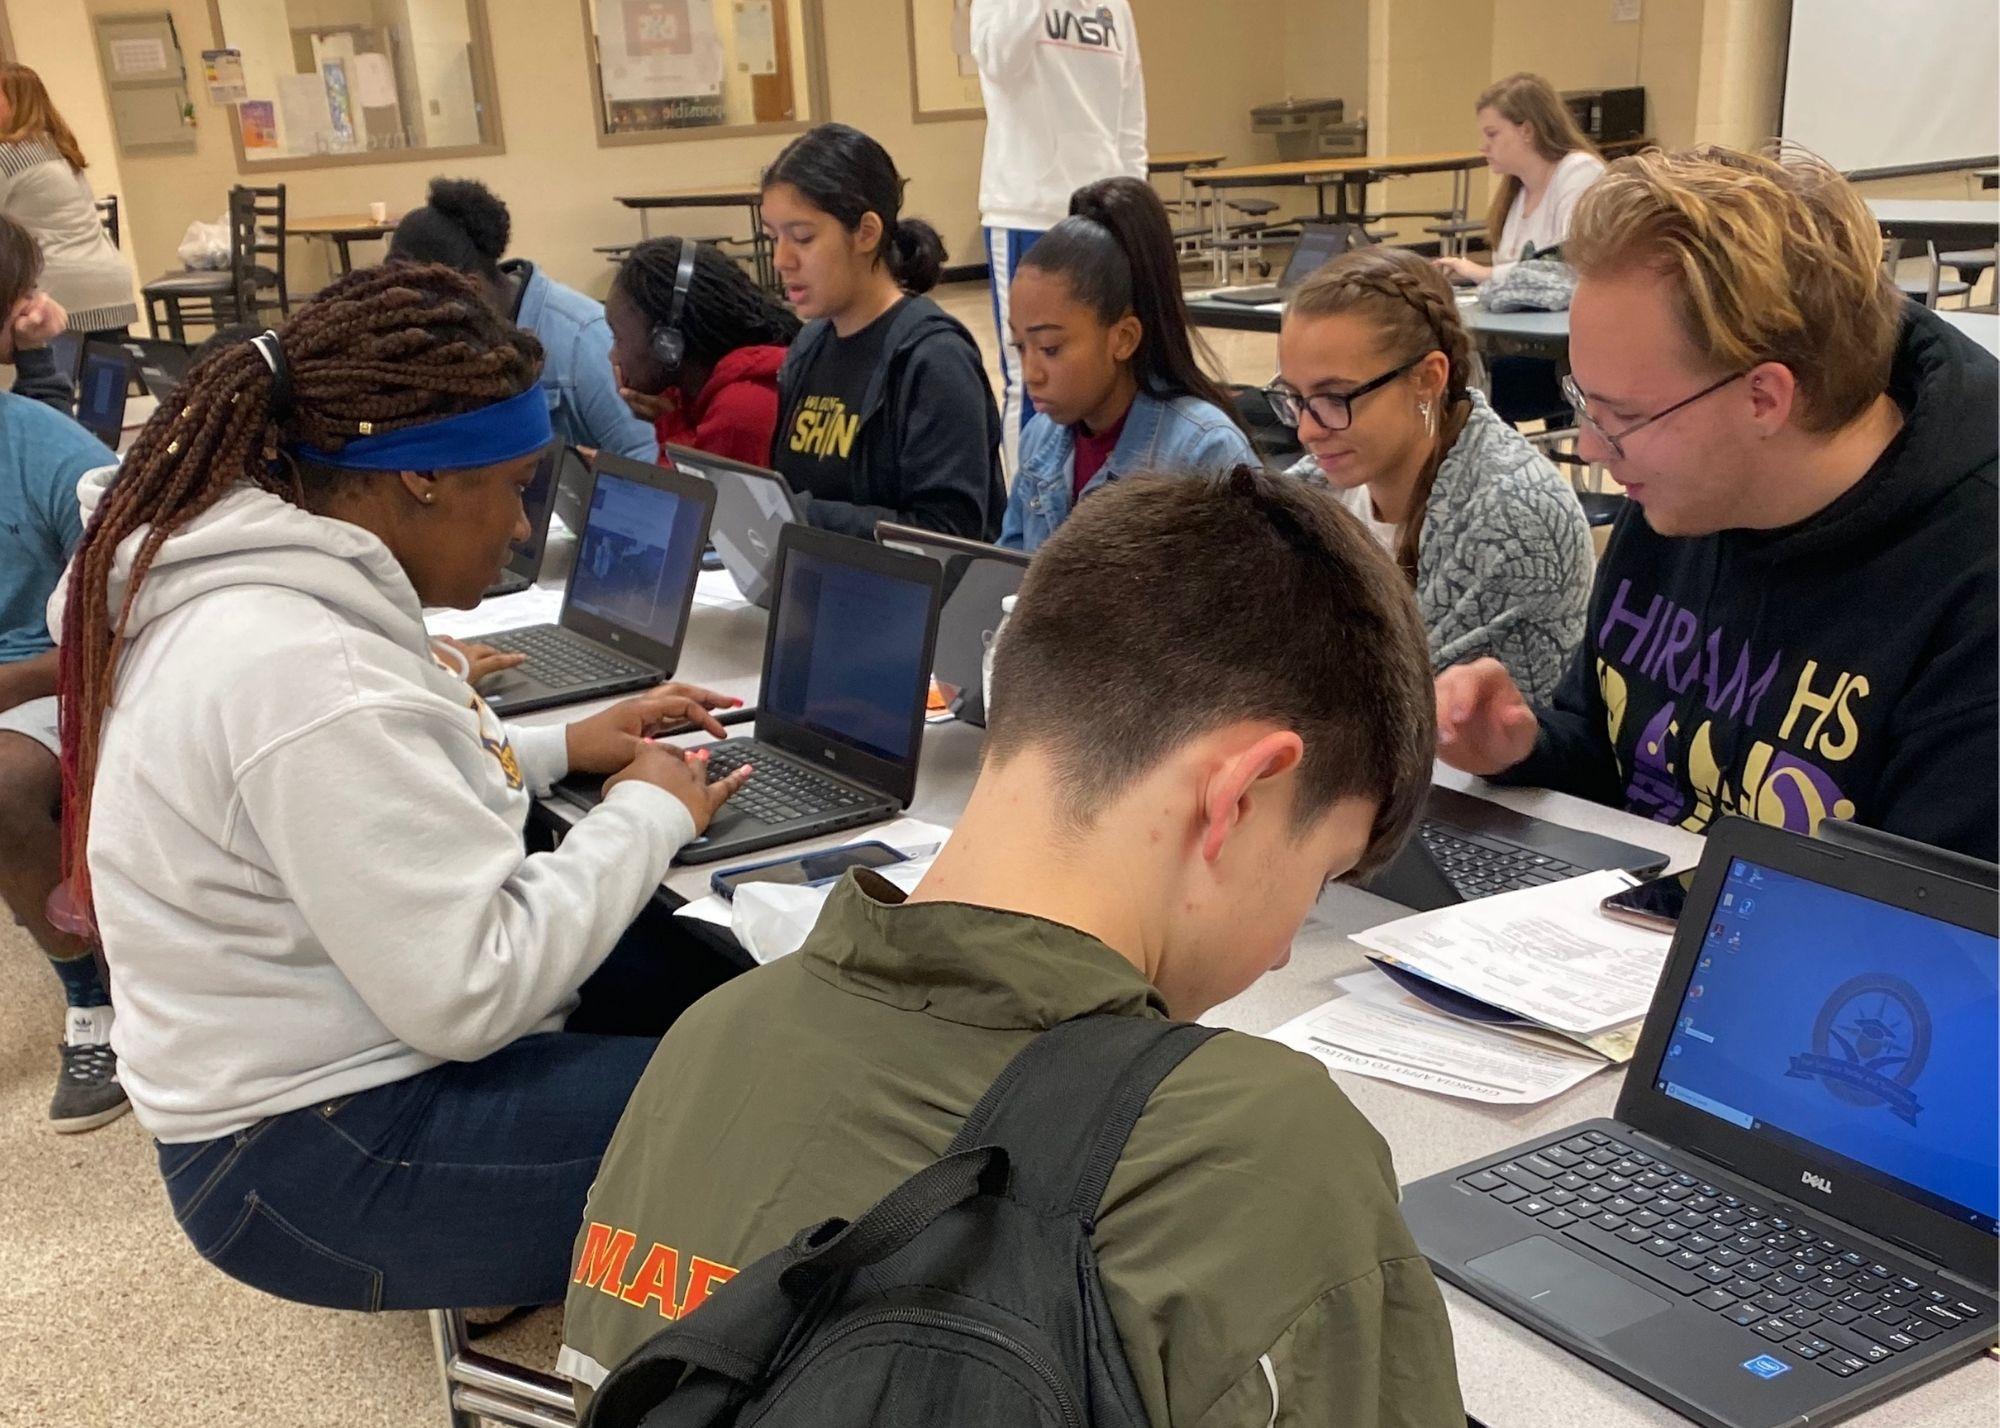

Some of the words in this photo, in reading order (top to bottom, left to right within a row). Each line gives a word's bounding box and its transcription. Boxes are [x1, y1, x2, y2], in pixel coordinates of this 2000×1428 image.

[1598, 577, 1783, 728] HIRAM
[1777, 659, 1870, 762] HS
[1312, 1045, 1369, 1066] COLLEGE
[1371, 1061, 1395, 1074] TO
[1395, 1067, 1432, 1083] APPLY
[1436, 1077, 1501, 1097] GEORGIA
[1801, 1170, 1832, 1194] DELL
